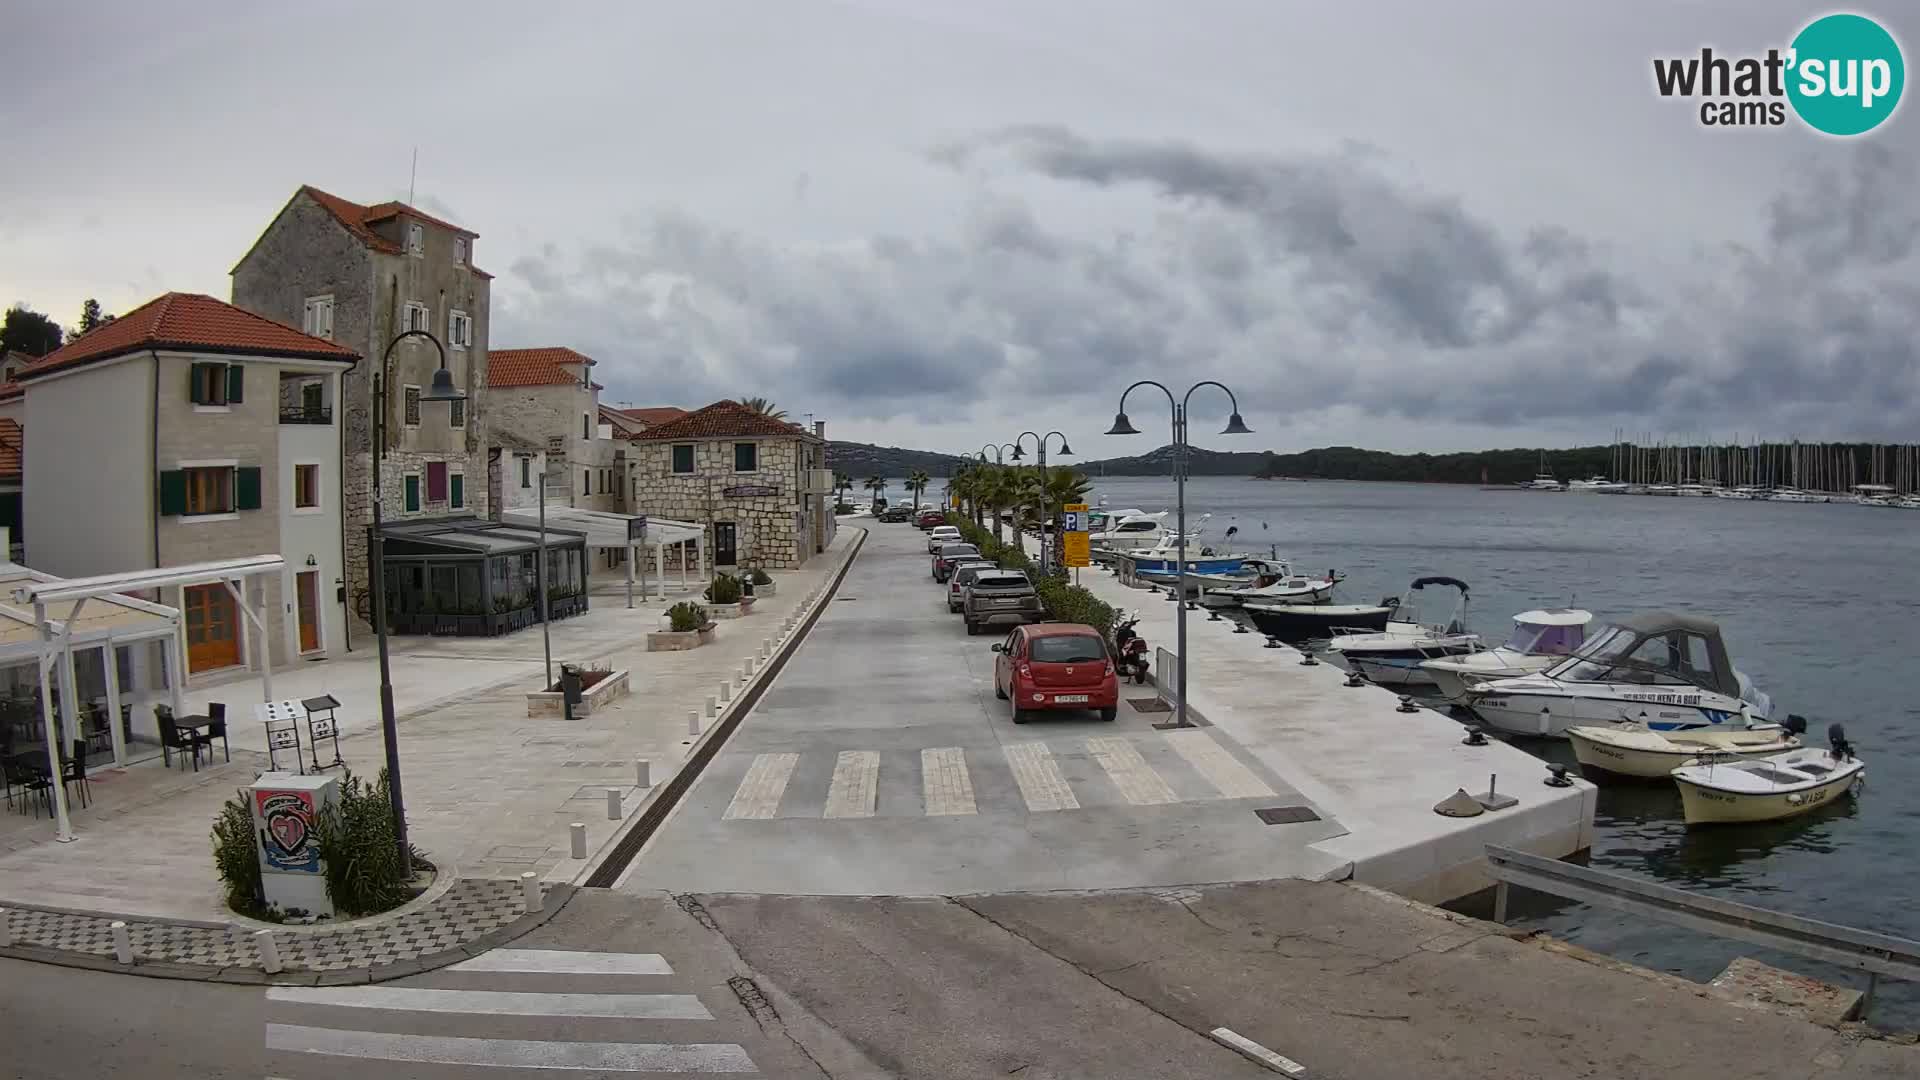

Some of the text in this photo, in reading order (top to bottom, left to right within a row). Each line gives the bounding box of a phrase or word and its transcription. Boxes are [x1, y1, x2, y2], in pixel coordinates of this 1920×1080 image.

[1066, 514, 1076, 529] P
[1657, 694, 1676, 704] RENT
[1683, 694, 1702, 705] BOAT
